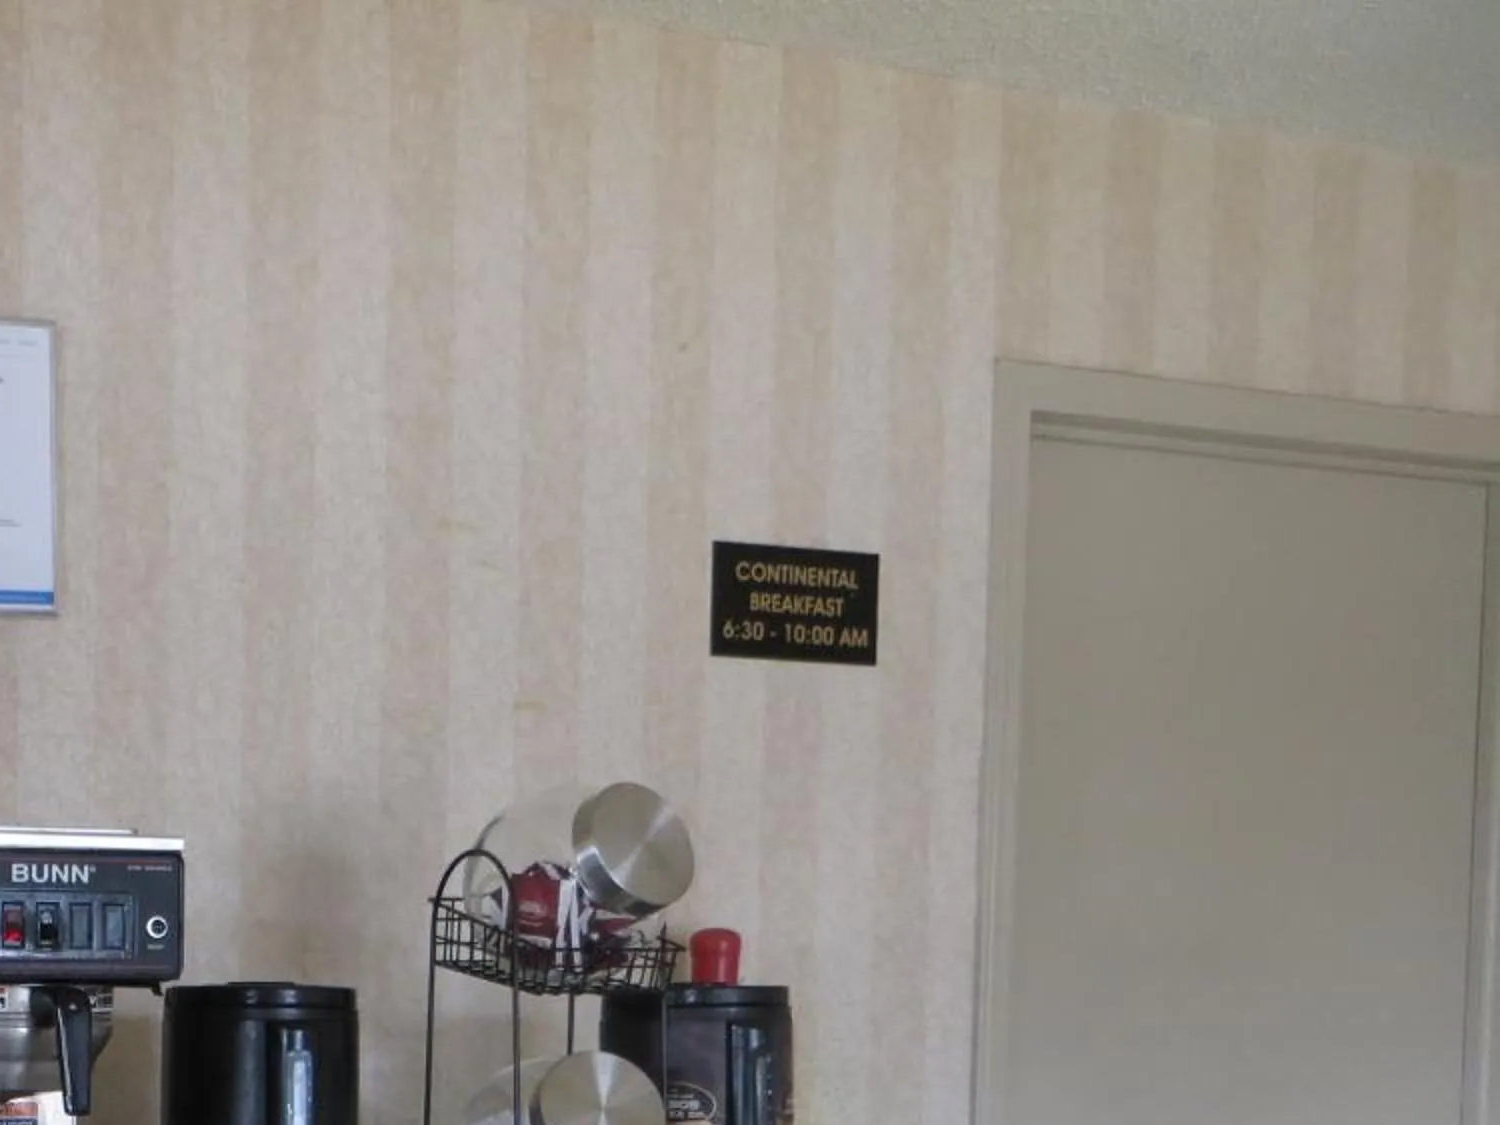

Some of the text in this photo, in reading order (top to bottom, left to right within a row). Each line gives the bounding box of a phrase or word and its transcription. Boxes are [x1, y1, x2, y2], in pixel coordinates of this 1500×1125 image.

[735, 561, 859, 589] CONTINENTAL
[750, 592, 844, 617] BREAKFAST
[722, 618, 765, 641] 6:30
[785, 623, 834, 646] 10:00
[839, 627, 869, 648] AM
[11, 863, 90, 884] BUNN
